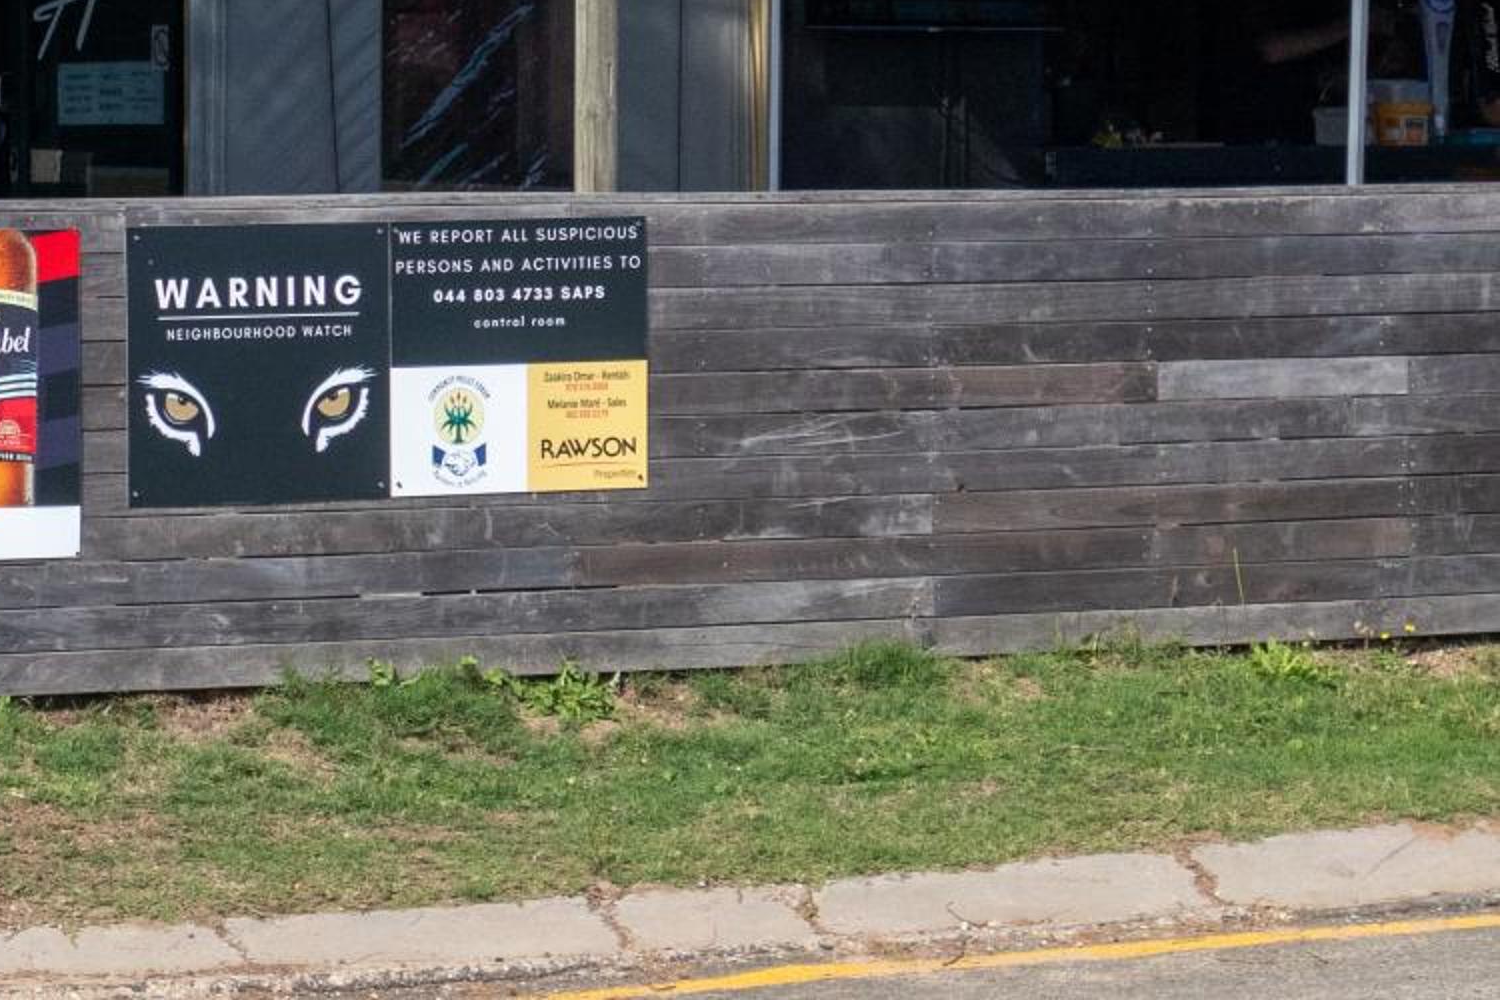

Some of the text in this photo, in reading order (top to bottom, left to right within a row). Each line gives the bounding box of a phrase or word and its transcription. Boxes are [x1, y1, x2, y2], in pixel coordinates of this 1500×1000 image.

[399, 225, 638, 244] WE REPORT ALL SUSPICIOUS
[395, 255, 642, 275] PERSONS AND ACTIVITIES TO
[154, 274, 362, 310] WARNING
[433, 285, 606, 303] 044 803 4733 SAPS
[473, 315, 566, 329] control room
[166, 324, 352, 341] NEIGHBOURHOOD WATCH
[541, 437, 637, 460] RAWSON
